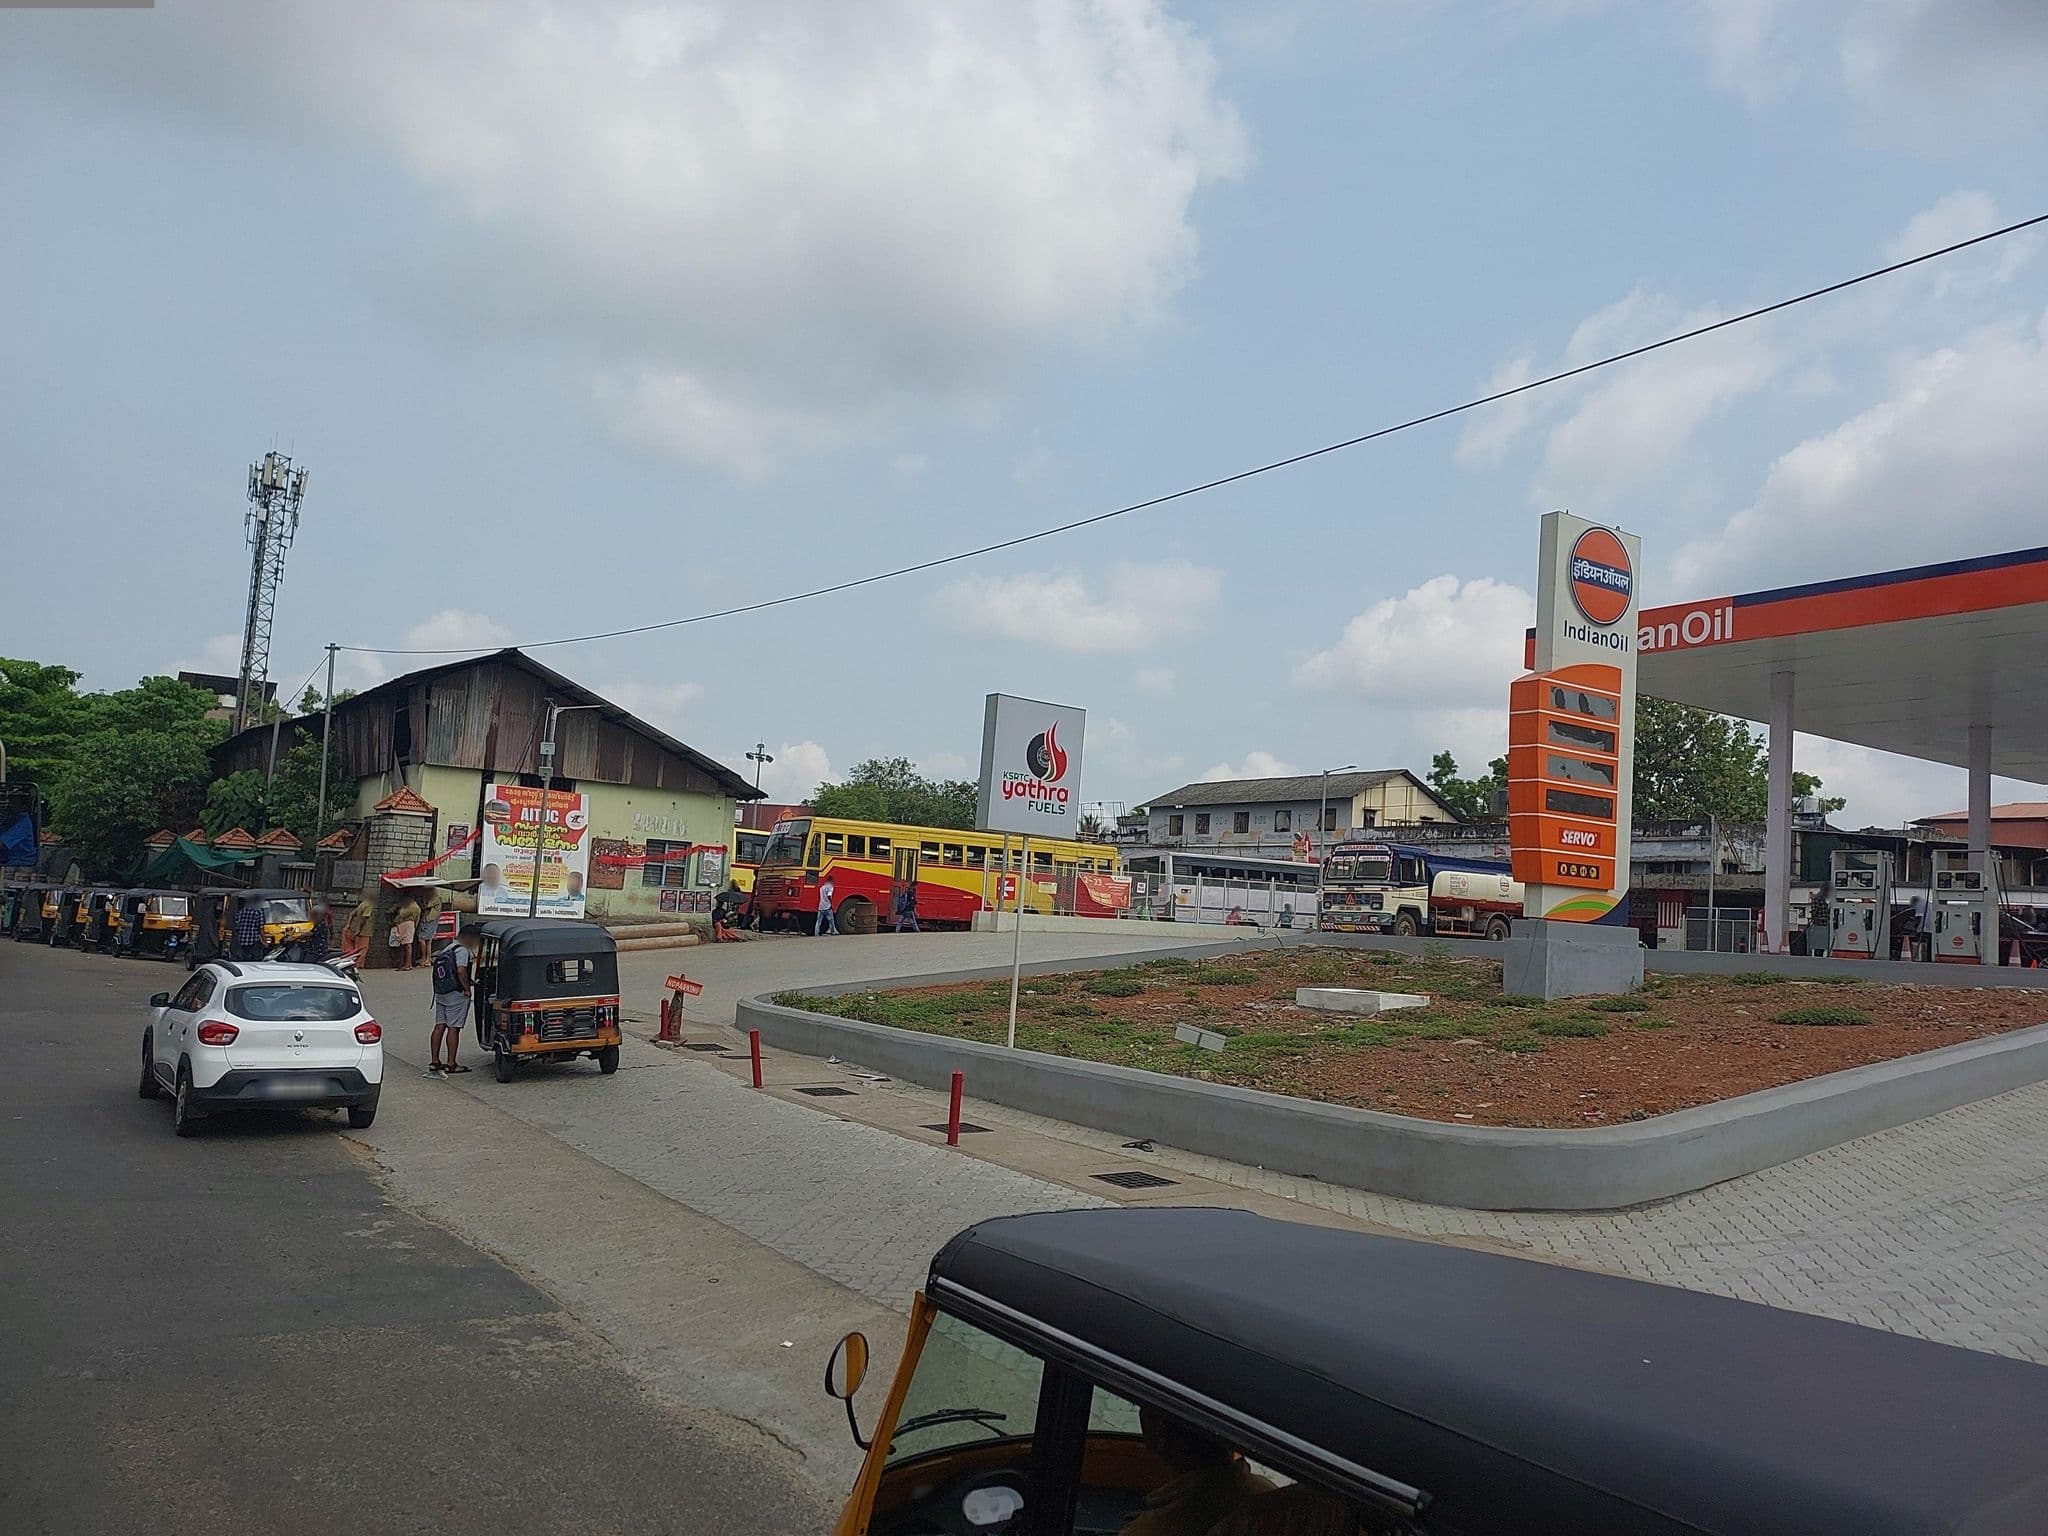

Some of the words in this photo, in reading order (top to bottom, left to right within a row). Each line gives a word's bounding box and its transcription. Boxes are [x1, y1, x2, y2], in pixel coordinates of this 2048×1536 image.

[1573, 559, 1629, 590] इंडियनऑयल
[1563, 620, 1629, 652] IndianOil
[1003, 771, 1029, 783] KSRTC
[1002, 779, 1068, 803] yathra
[1028, 801, 1066, 815] FUELS
[1561, 829, 1596, 846] SERVO
